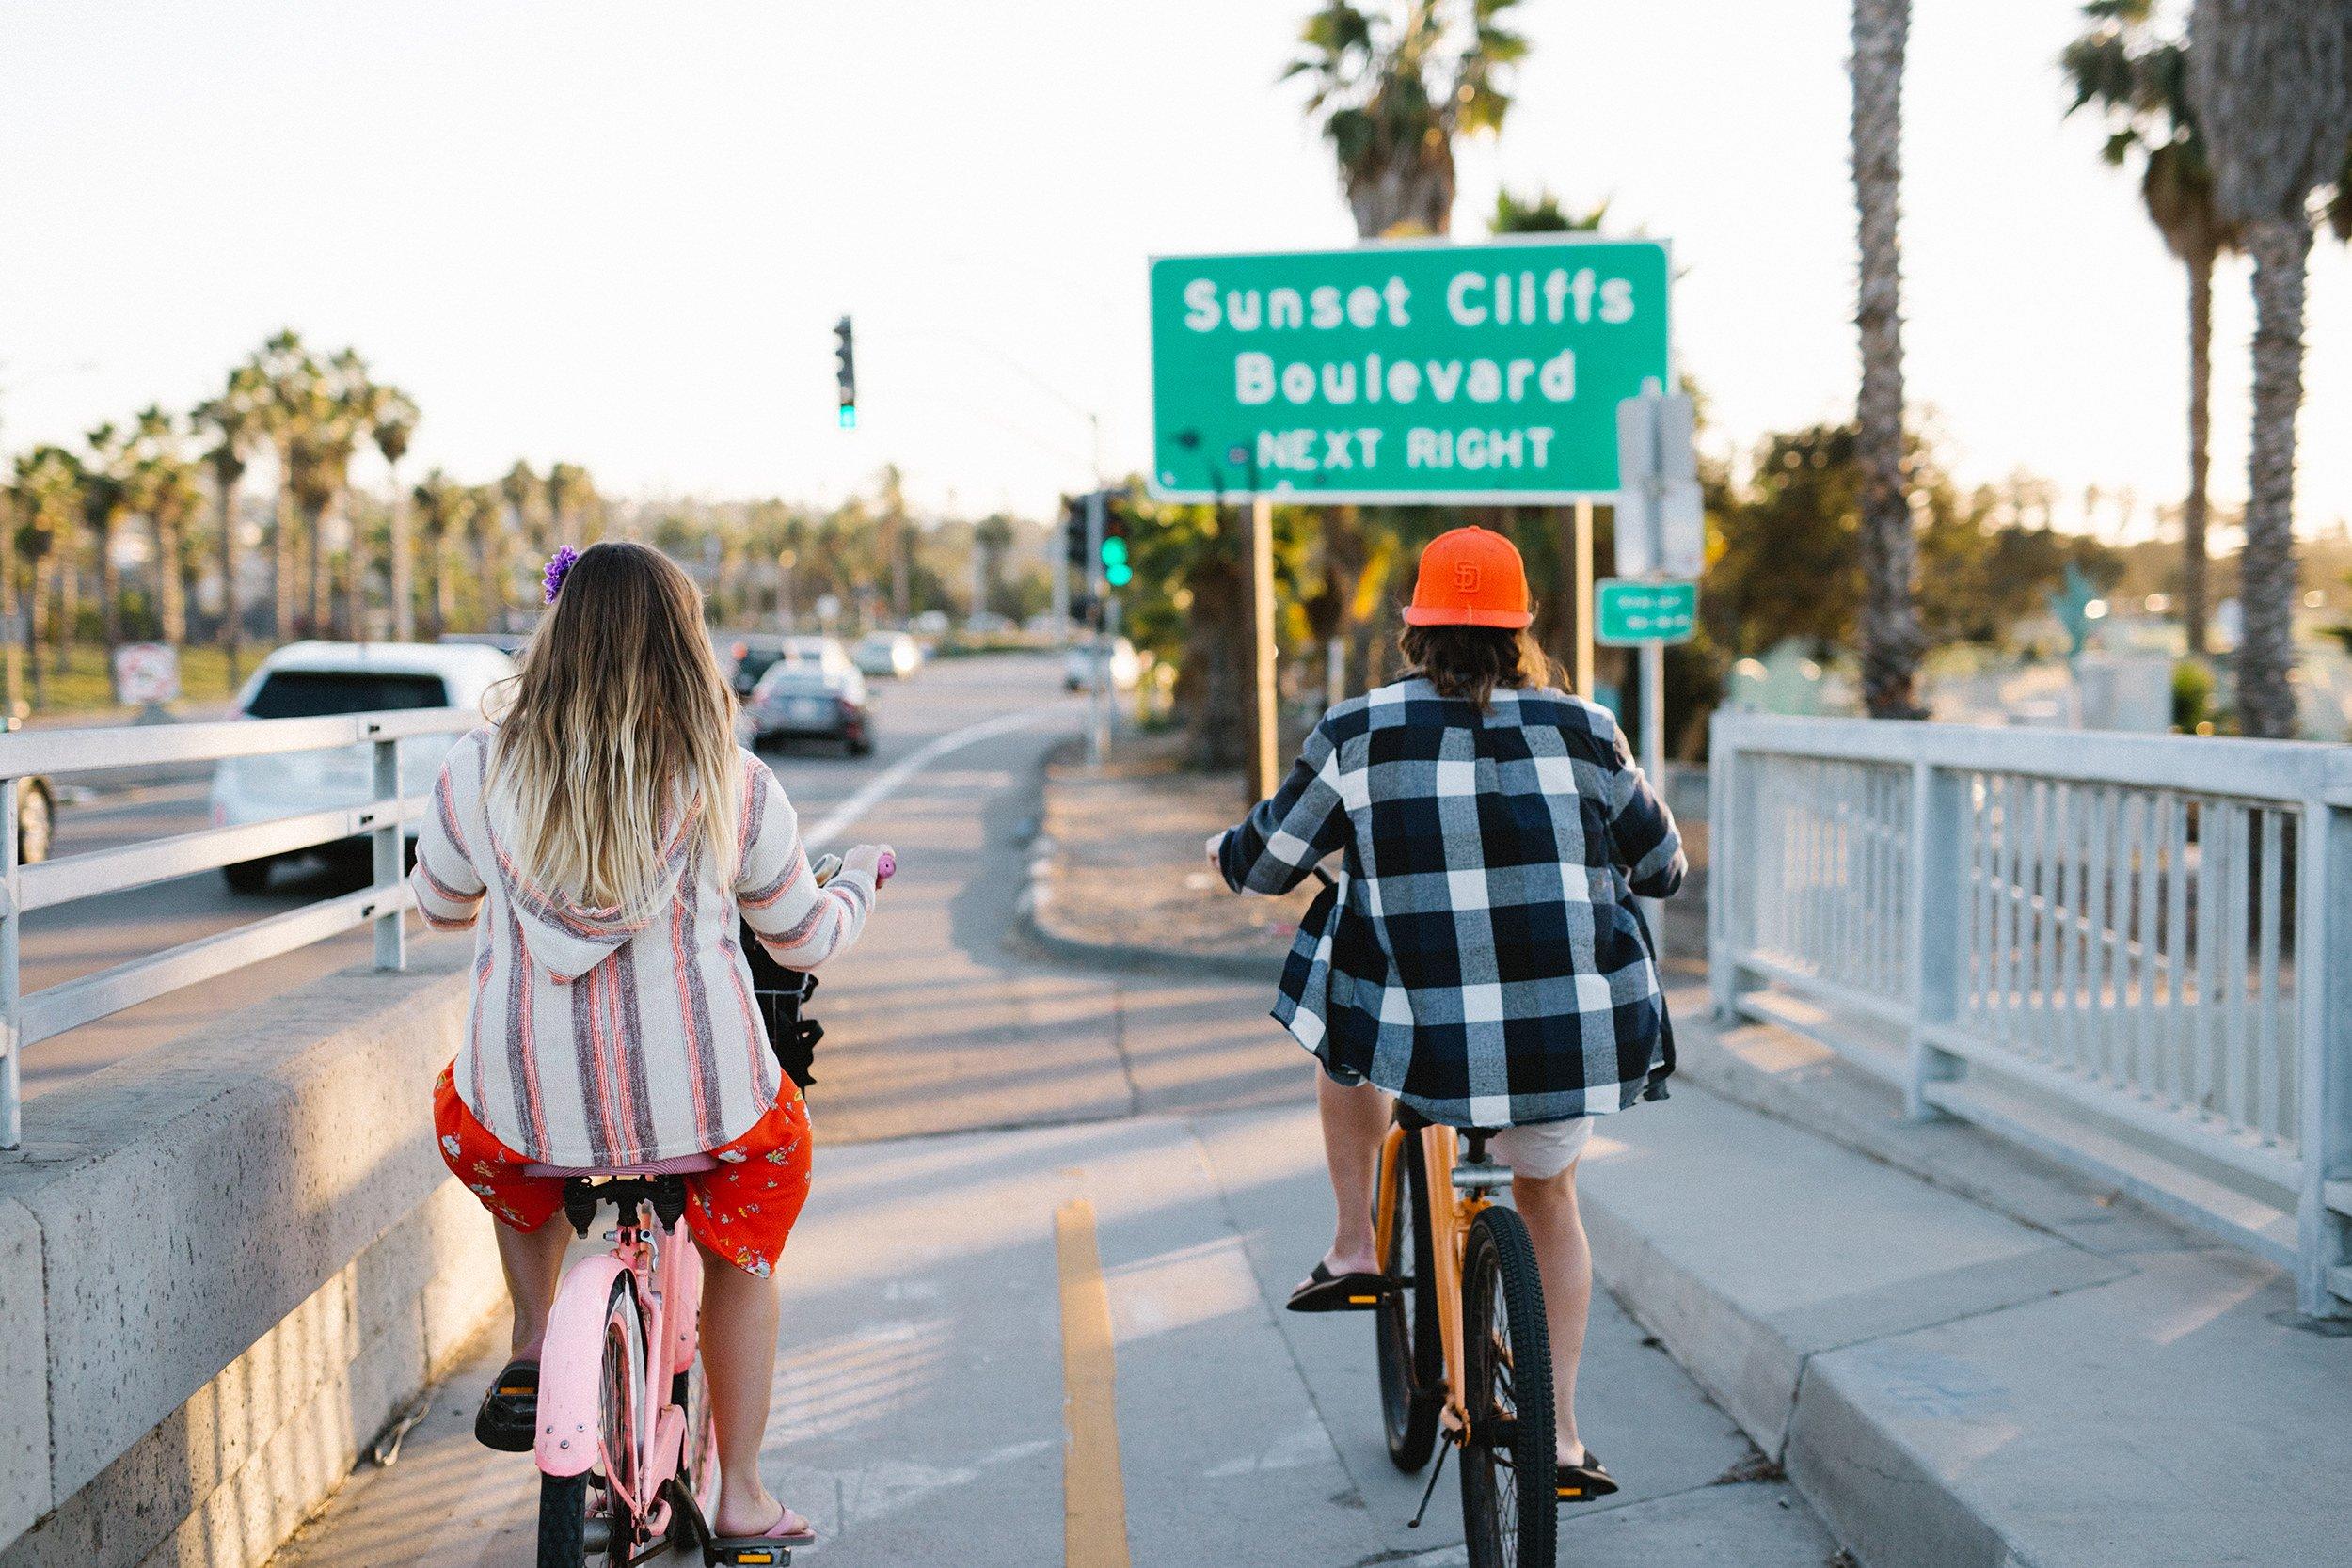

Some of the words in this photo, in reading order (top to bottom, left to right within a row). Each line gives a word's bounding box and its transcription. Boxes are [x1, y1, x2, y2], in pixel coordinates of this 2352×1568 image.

[1184, 277, 1410, 331] Sunset
[1447, 268, 1635, 325] Cliffs
[1235, 349, 1575, 404] Boulevard
[1257, 428, 1382, 470] NEXT
[1407, 427, 1554, 469] RIGHT
